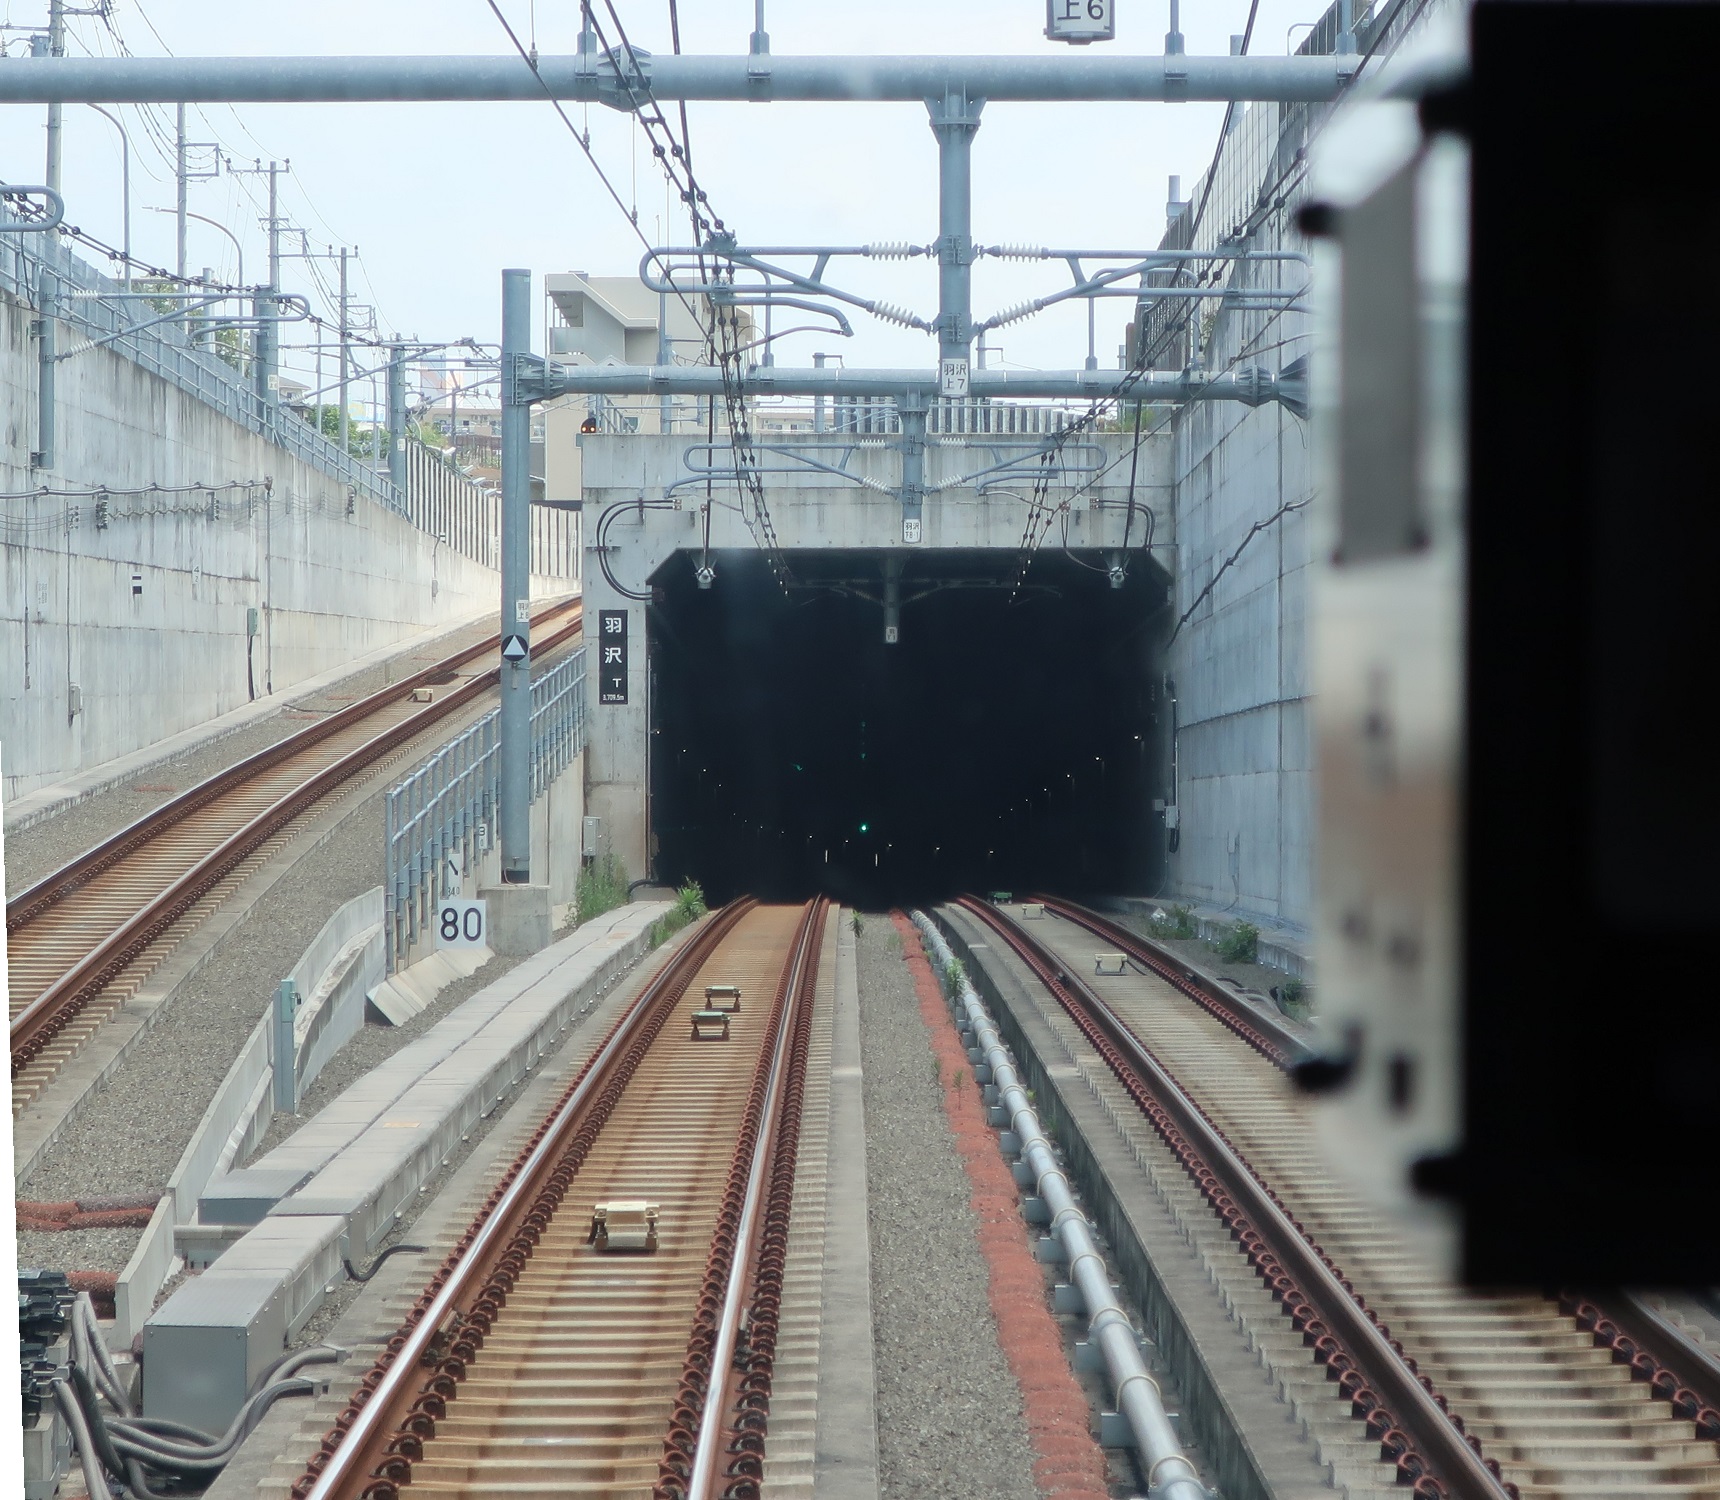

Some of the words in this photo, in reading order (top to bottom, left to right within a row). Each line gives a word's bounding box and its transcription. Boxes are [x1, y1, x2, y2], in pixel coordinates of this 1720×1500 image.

[943, 363, 967, 376] 羽沢
[905, 522, 920, 531] 羽沢
[440, 907, 482, 942] 80
